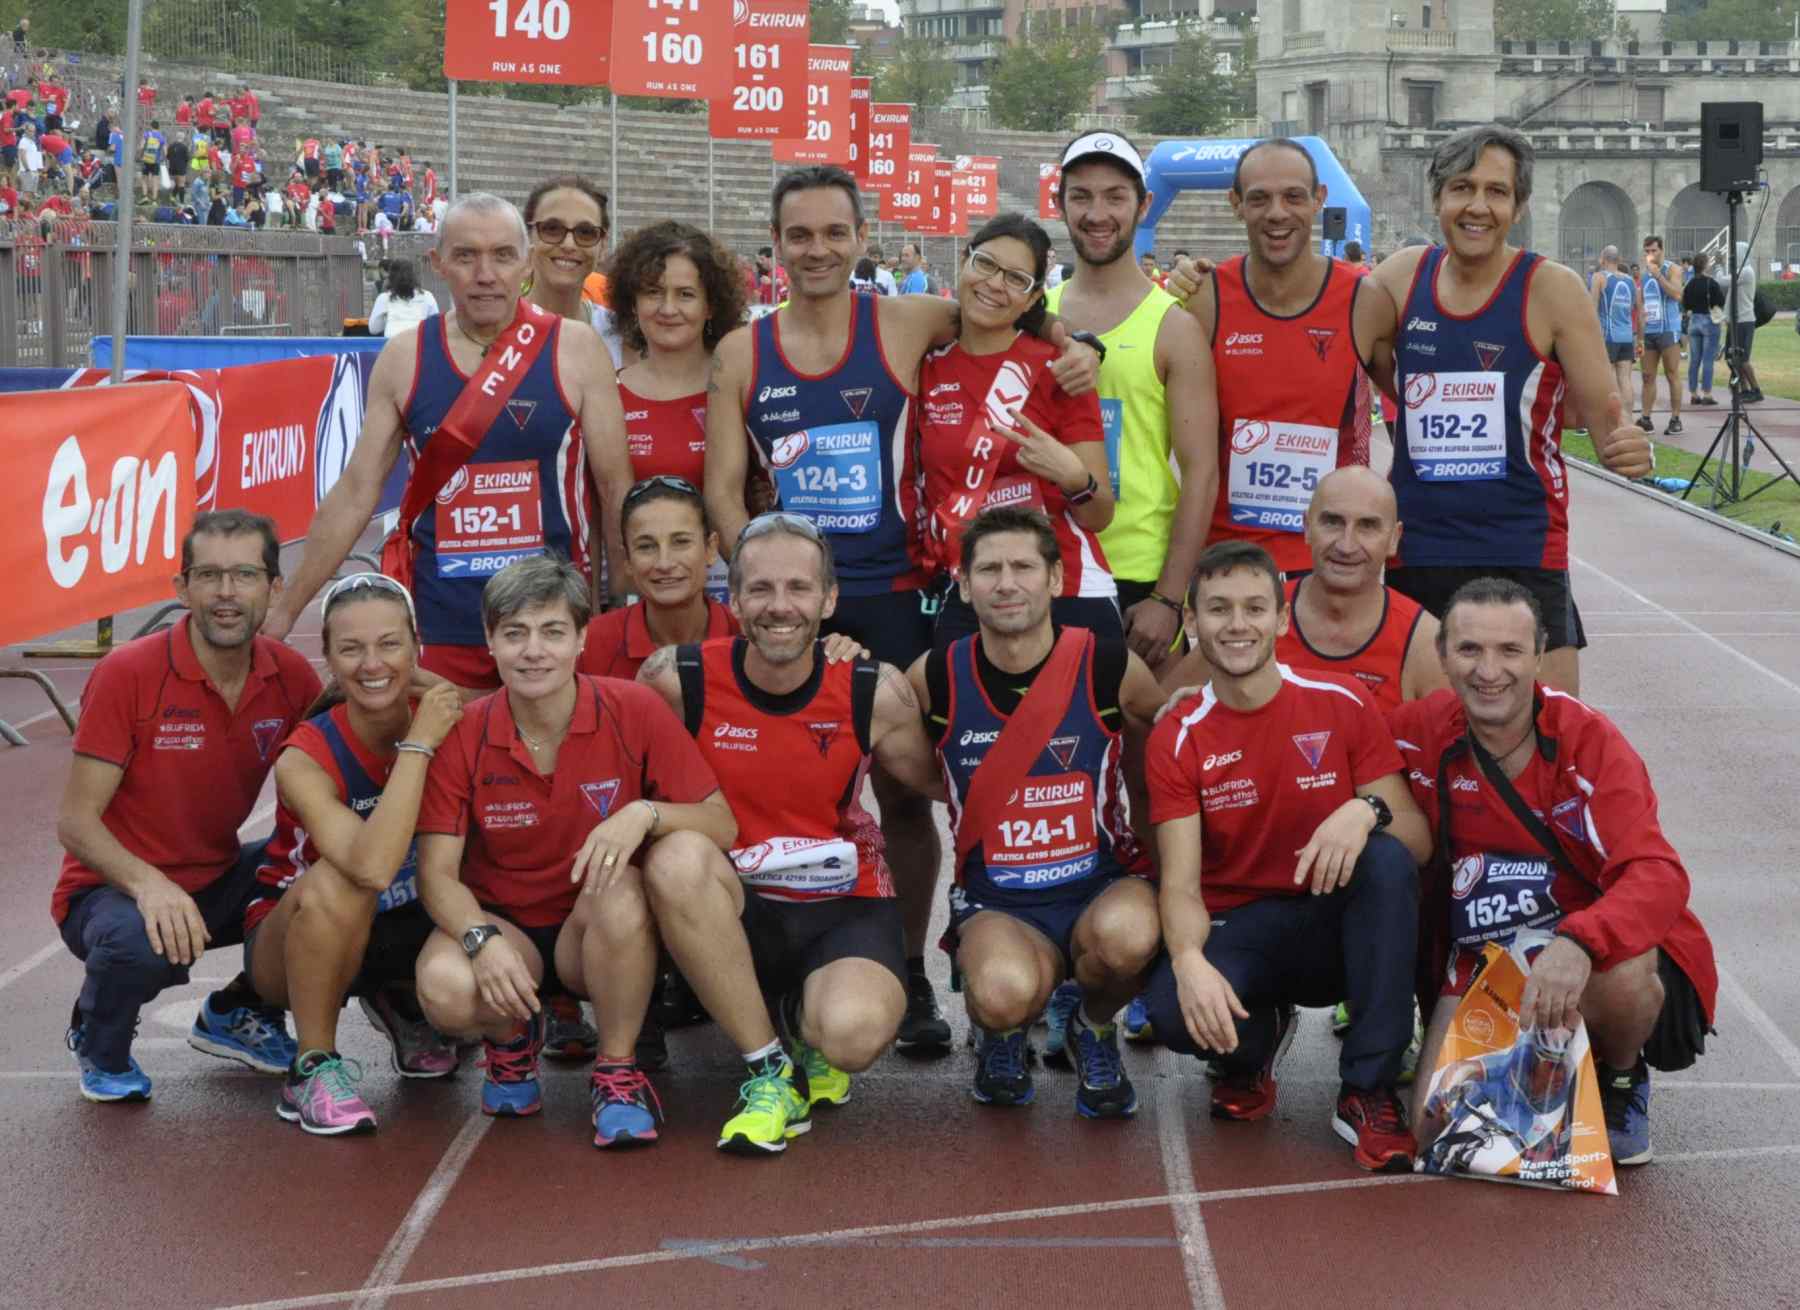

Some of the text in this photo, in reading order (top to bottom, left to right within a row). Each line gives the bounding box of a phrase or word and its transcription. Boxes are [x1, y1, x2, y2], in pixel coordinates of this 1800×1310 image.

[488, 0, 571, 40] 140
[750, 12, 806, 28] EKIRUN
[642, 32, 703, 65] 160
[734, 43, 780, 69] 161
[492, 61, 561, 75] RUN AS ONE
[732, 86, 784, 112] 200
[808, 84, 829, 107] 01
[892, 192, 921, 208] 380
[1442, 383, 1496, 396] EKIRUN
[1419, 413, 1488, 439] 152-2
[816, 431, 873, 450] EKIRUN
[1275, 433, 1331, 451] EKIRUN
[241, 424, 300, 490] EKIRUN
[474, 471, 533, 489] EKIRUN
[792, 464, 868, 492] 124-3
[1246, 461, 1319, 491] 152-5
[1433, 462, 1501, 476] BROOKS
[450, 503, 522, 534] 152-1
[817, 512, 878, 529] BROOKS
[728, 726, 759, 739] asics
[1215, 750, 1243, 768] asics
[1023, 780, 1086, 802] EKIRUN
[998, 815, 1078, 848] 124-1
[1023, 855, 1094, 884] BROOKS
[1487, 862, 1548, 877] EKIRUN
[1465, 889, 1540, 929] 152-6
[1519, 1169, 1544, 1180] The
